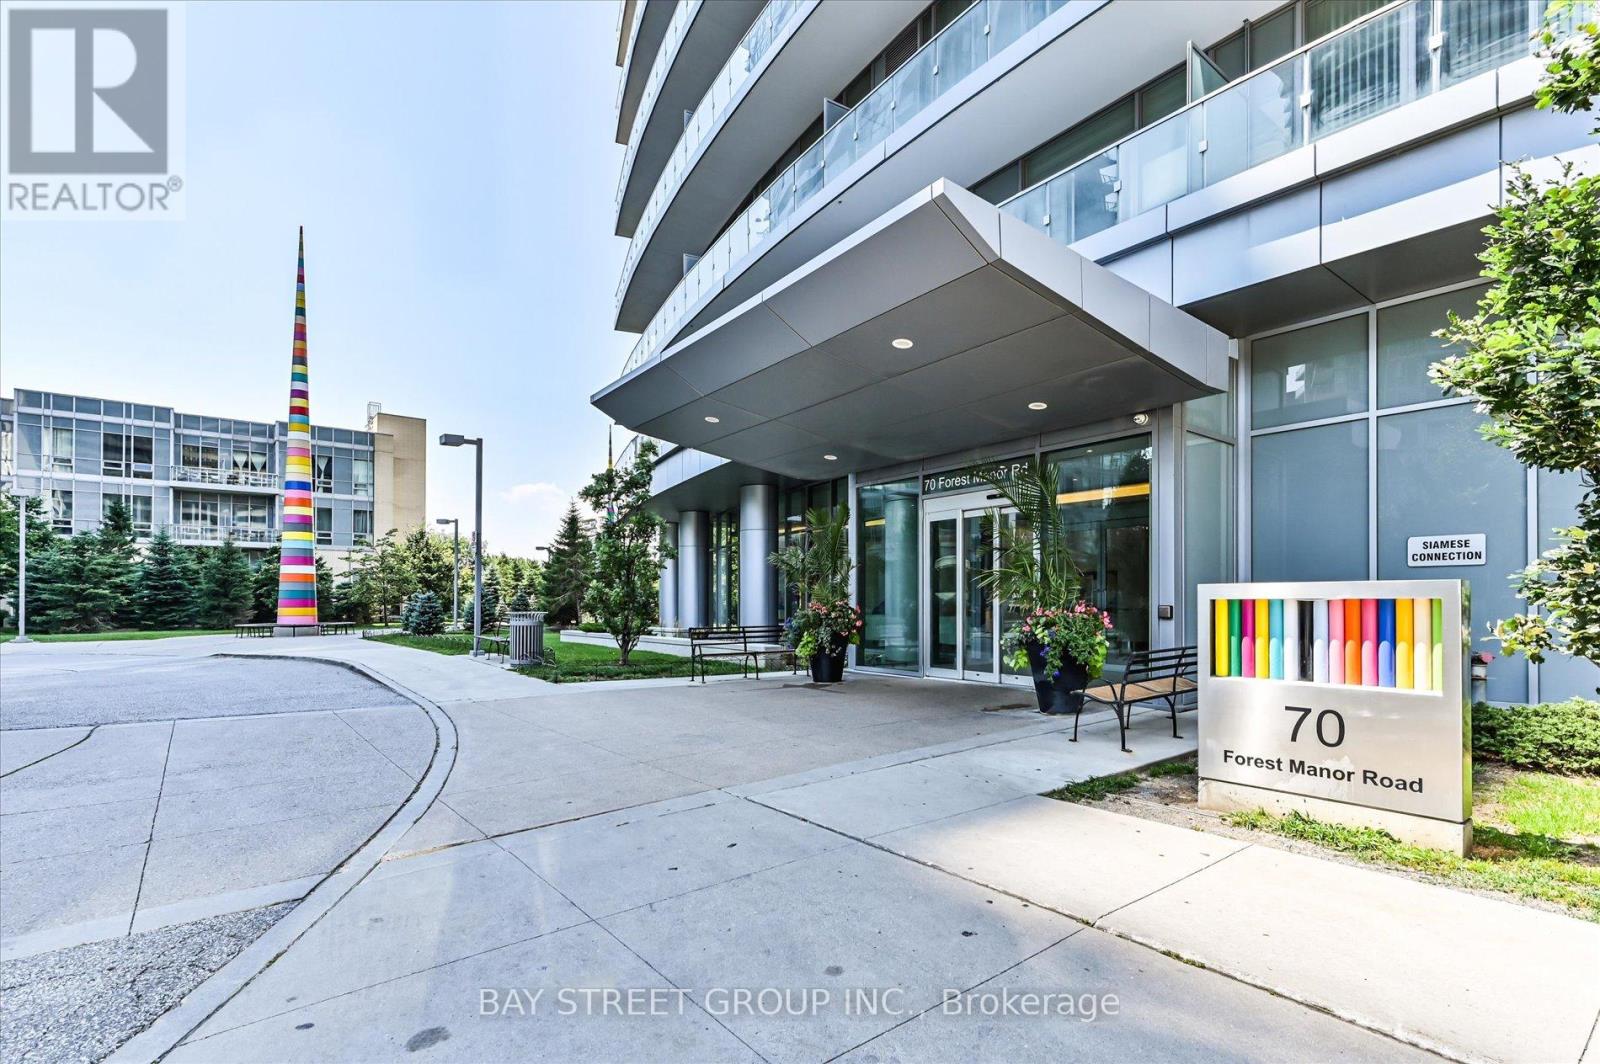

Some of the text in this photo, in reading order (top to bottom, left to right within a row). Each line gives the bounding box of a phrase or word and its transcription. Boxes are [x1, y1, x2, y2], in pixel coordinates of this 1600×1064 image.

[924, 478, 937, 492] 70
[938, 475, 970, 489] Forest
[1422, 539, 1470, 550] SIAMESE
[1411, 551, 1482, 562] CONNECTION
[1284, 705, 1346, 748] 70
[1223, 749, 1424, 794] Forest Manor Road
